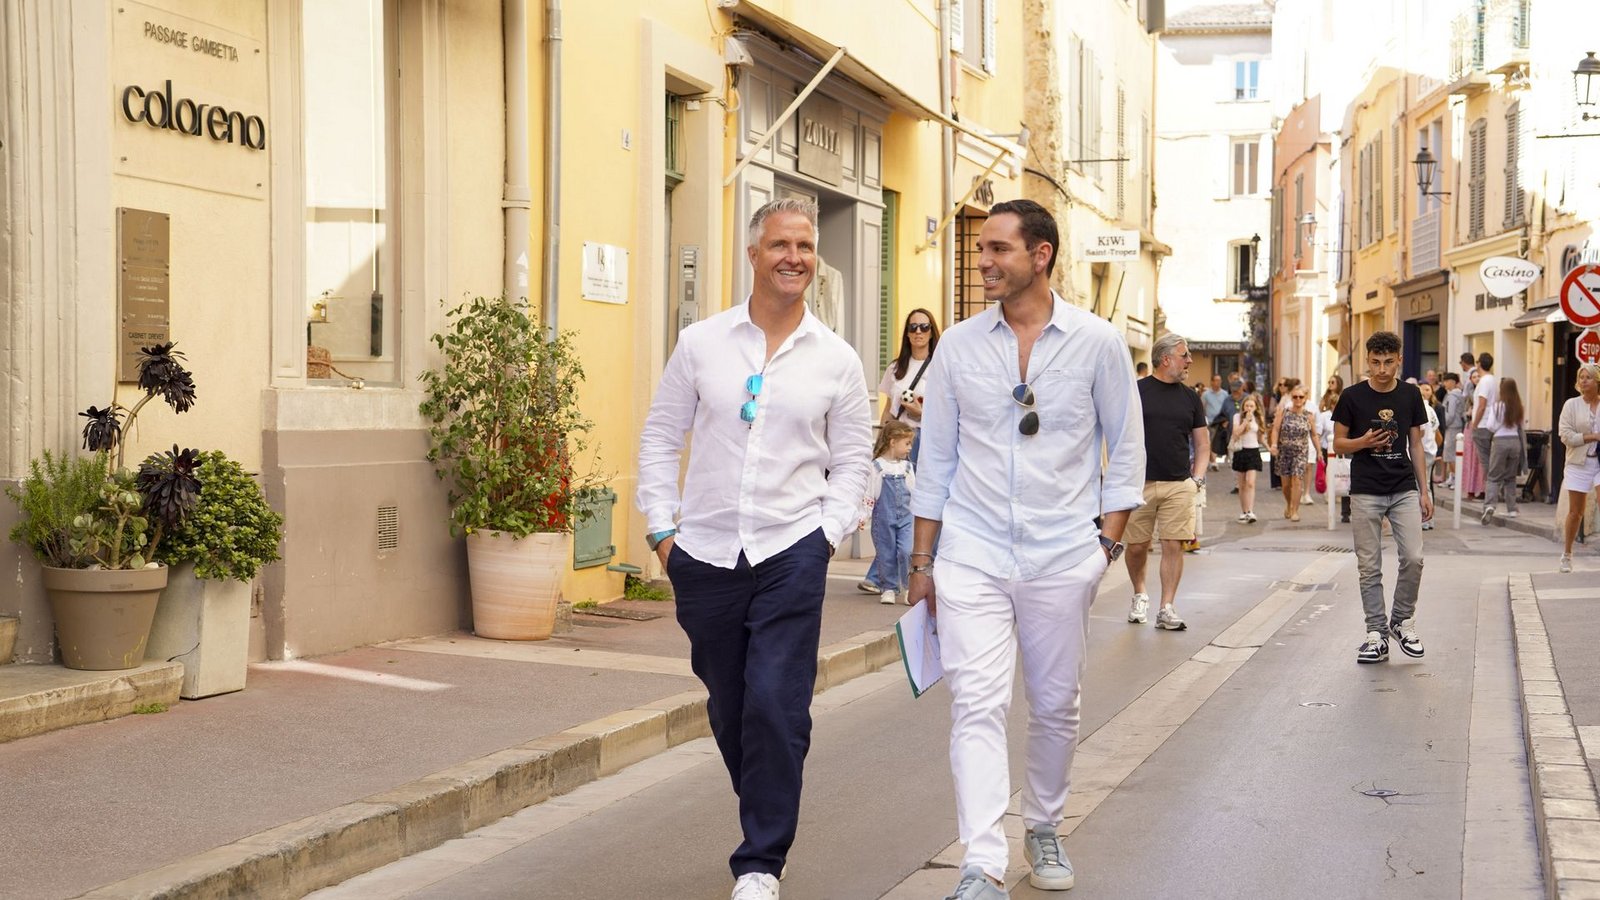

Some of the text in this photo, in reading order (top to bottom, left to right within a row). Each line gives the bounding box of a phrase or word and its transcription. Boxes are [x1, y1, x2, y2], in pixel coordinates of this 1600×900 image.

[144, 21, 238, 62] PASSAGE GAMBETTA
[1085, 248, 1136, 256] Saint-Tropez
[1483, 265, 1534, 279] Casino
[1581, 342, 1600, 355] STOP
